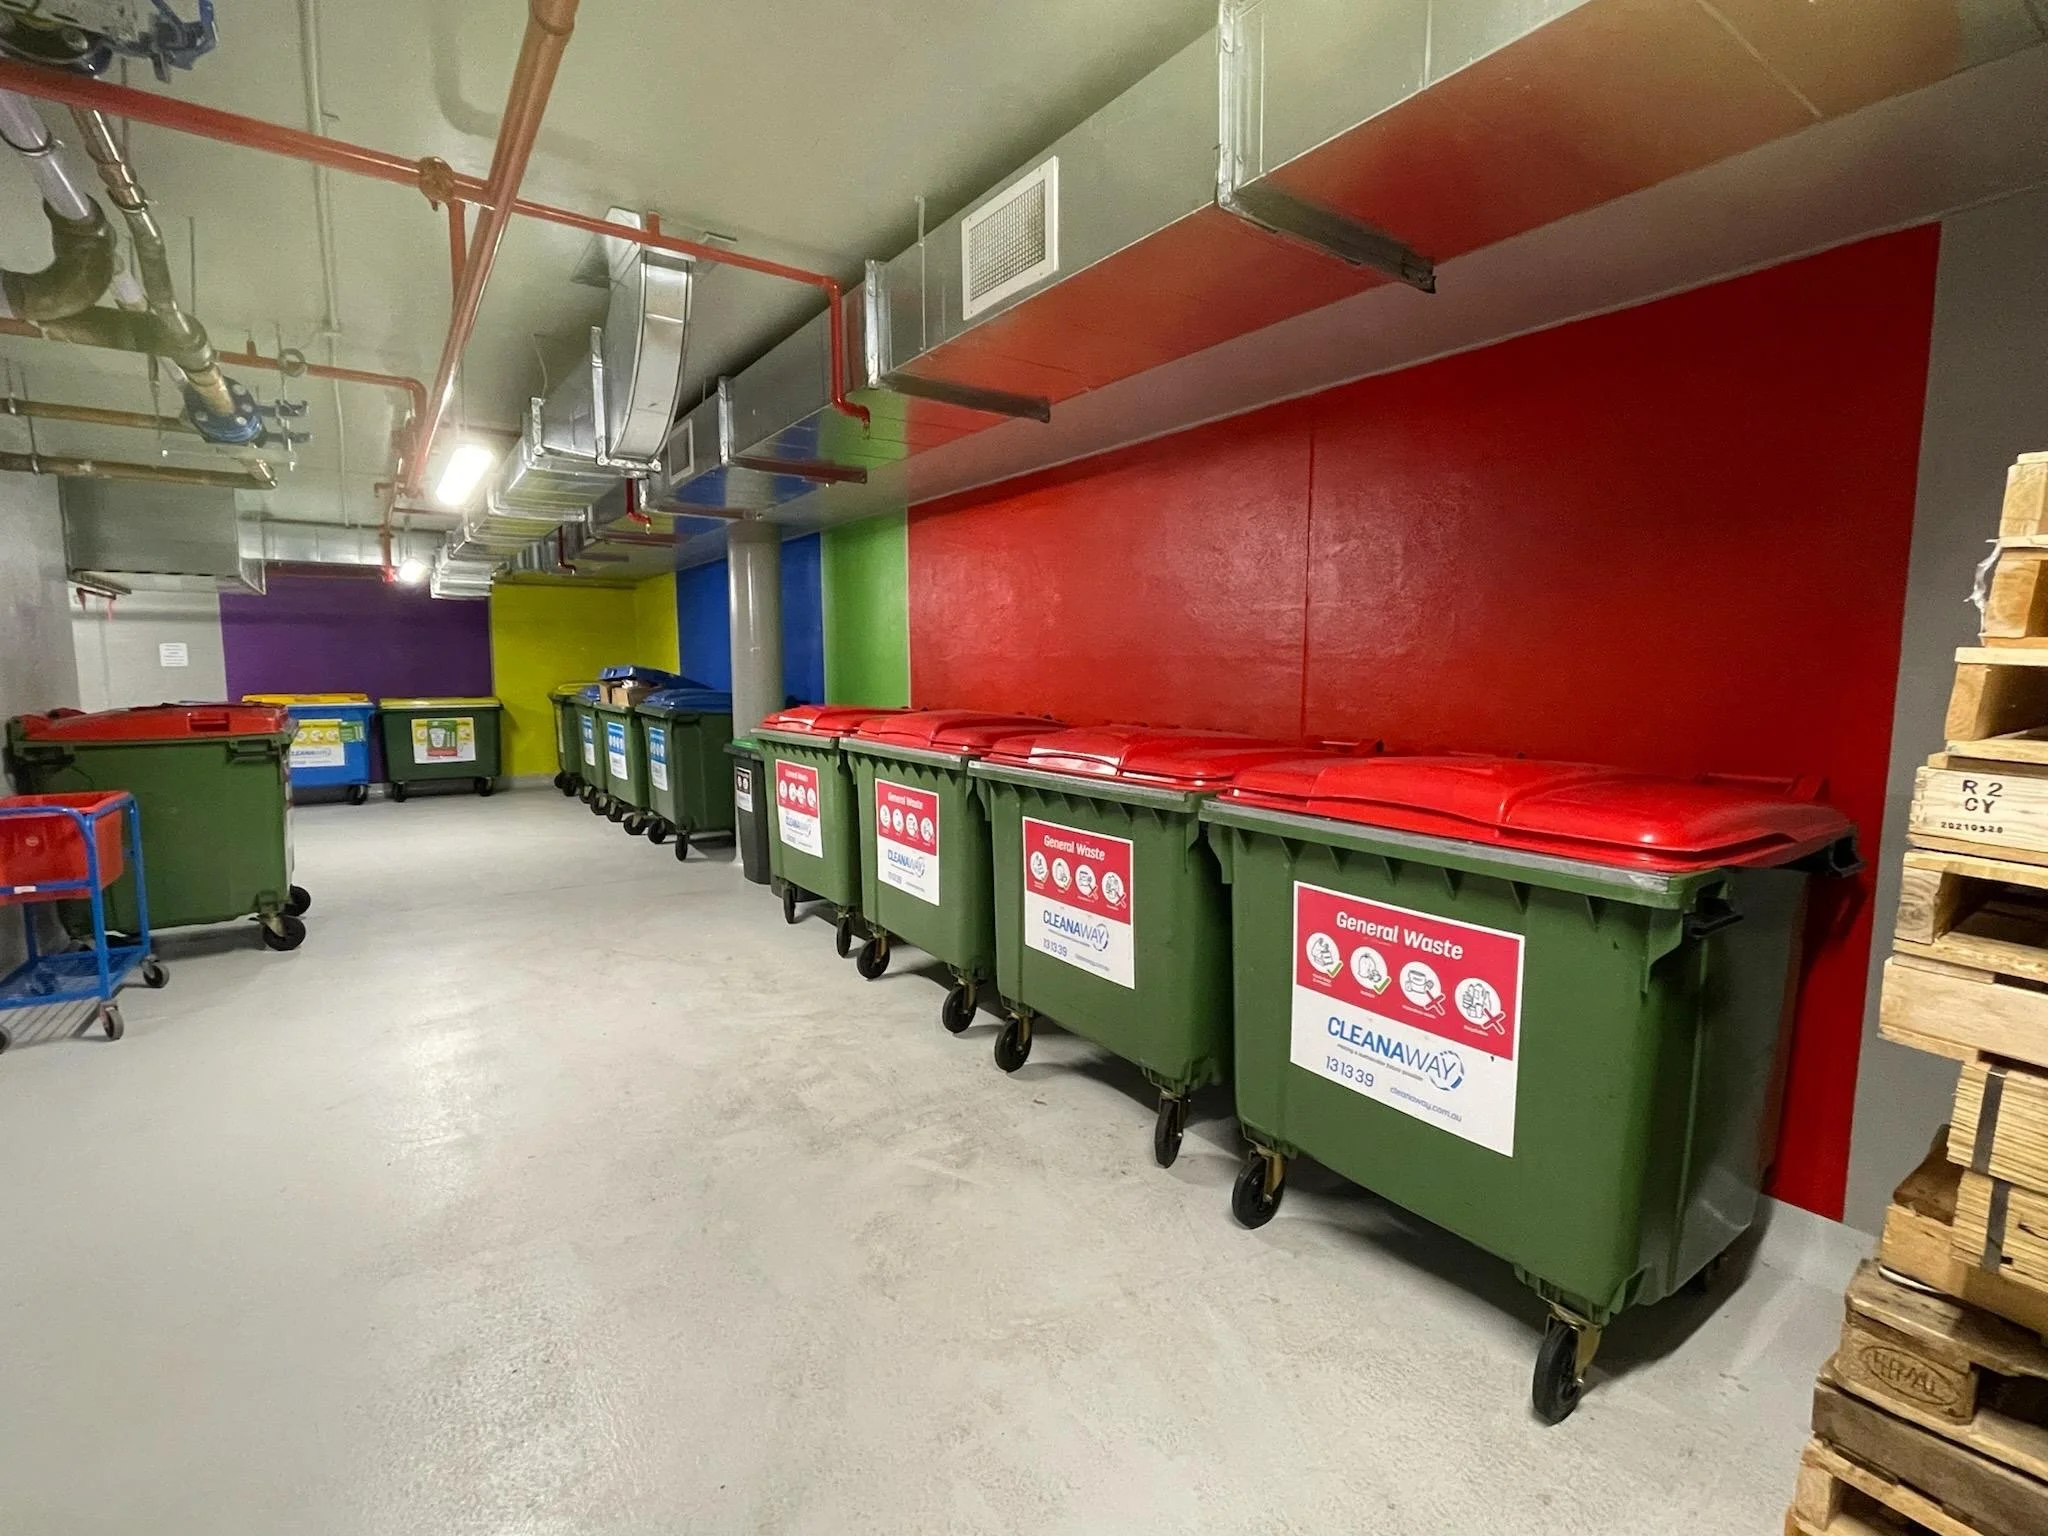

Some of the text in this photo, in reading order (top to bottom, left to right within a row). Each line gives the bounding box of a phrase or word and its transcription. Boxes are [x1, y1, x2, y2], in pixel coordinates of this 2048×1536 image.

[1964, 797, 1996, 814] CY
[1043, 834, 1106, 862] General Waste
[1042, 909, 1105, 945] CLEANAWAY
[1336, 911, 1399, 943] General
[1403, 928, 1464, 960] Waste
[1327, 1015, 1458, 1081] CLEANAWAY
